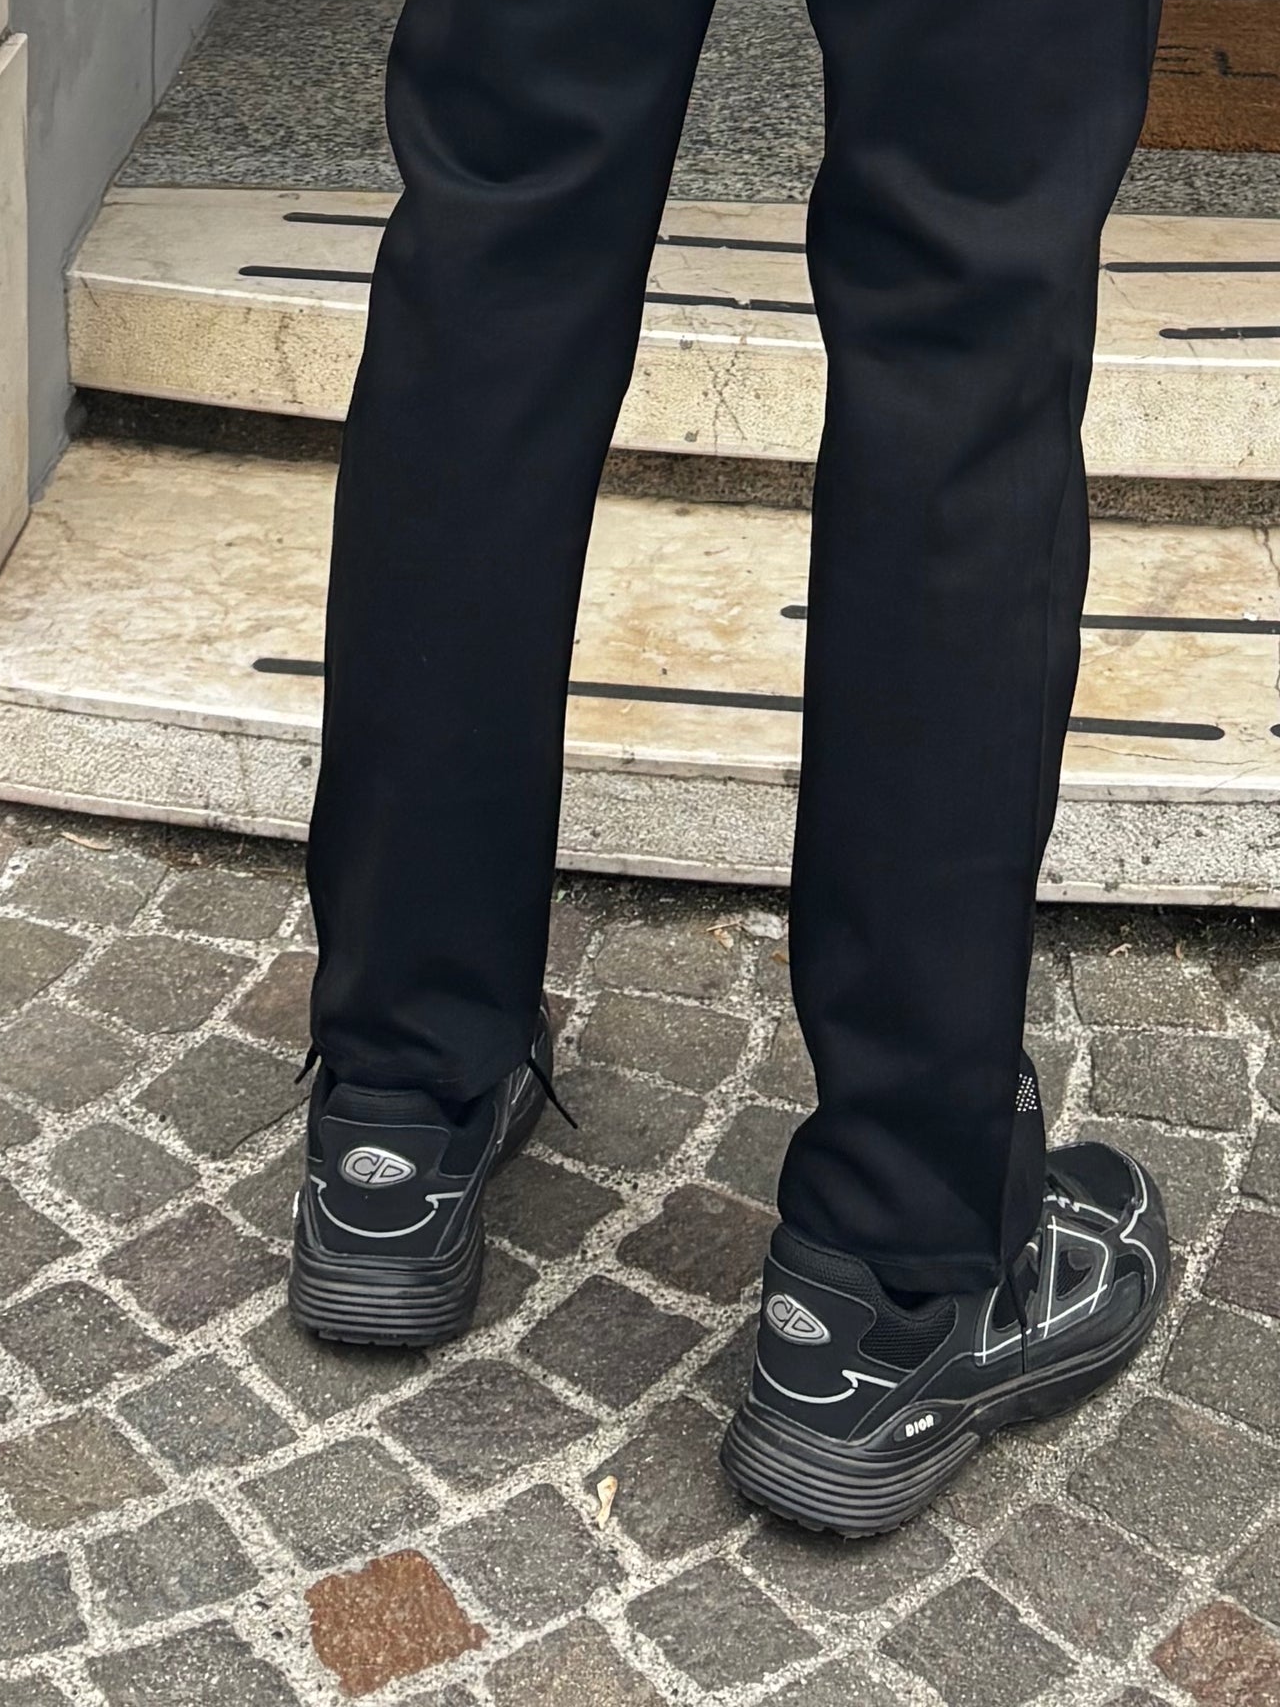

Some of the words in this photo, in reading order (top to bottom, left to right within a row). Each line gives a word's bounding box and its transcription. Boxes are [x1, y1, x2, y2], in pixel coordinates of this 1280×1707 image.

[343, 1150, 414, 1185] CD
[766, 1293, 825, 1340] CD
[905, 1414, 934, 1437] DIOR
